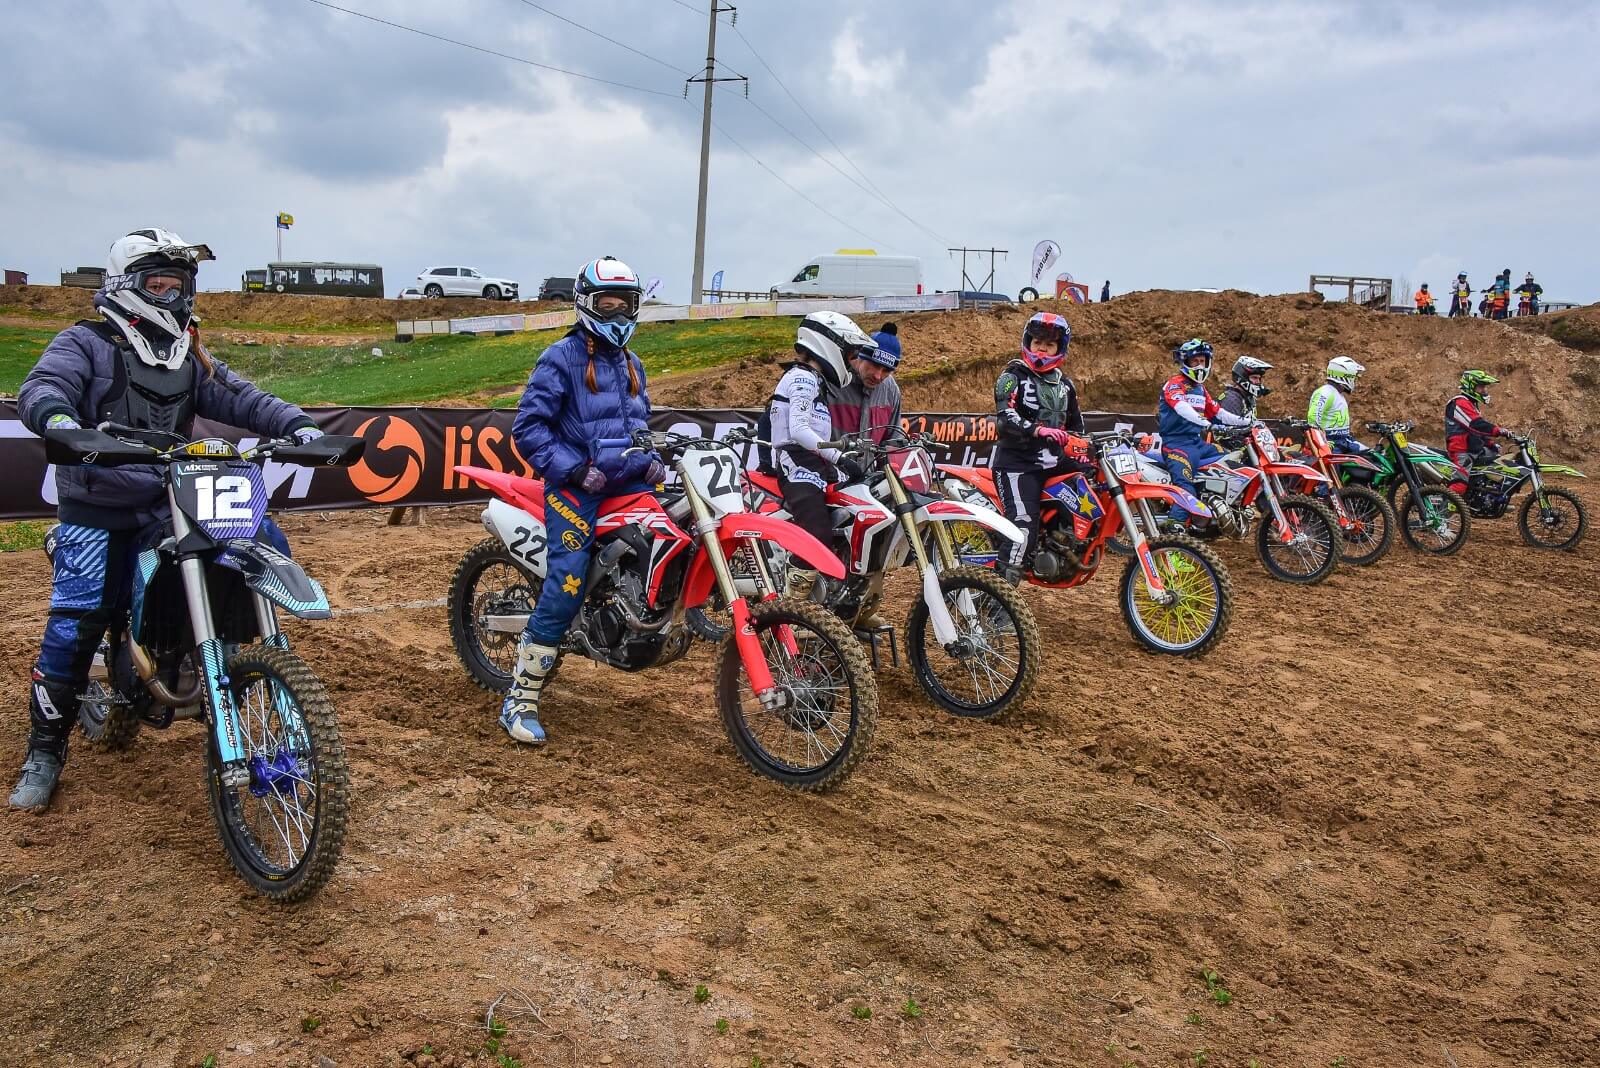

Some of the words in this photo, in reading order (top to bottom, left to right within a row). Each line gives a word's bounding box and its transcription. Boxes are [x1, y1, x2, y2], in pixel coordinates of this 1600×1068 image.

[195, 476, 253, 520] 12
[699, 455, 742, 498] 22
[546, 493, 591, 537] MANNOL
[510, 526, 547, 567] 22
